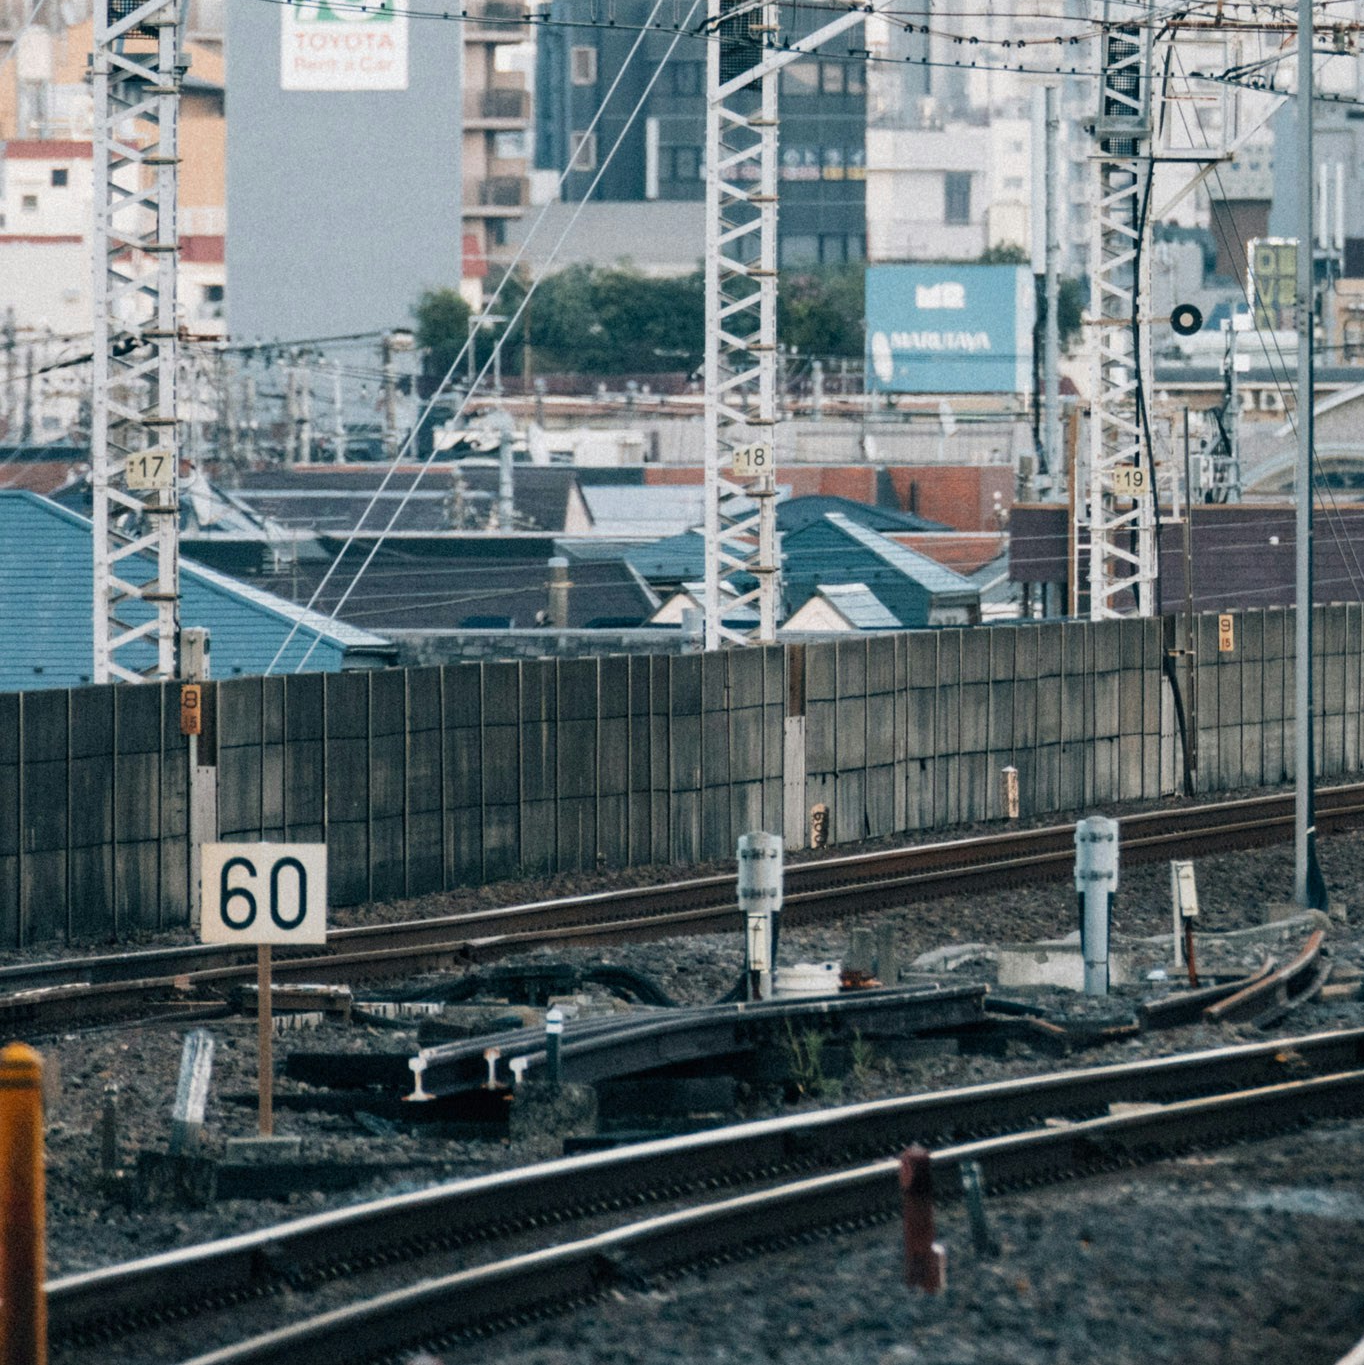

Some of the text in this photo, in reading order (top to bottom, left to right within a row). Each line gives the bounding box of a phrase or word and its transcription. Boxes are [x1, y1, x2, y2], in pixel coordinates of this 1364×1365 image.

[294, 32, 395, 51] TOYOTA
[743, 448, 765, 466] 18
[139, 456, 164, 478] 17
[1124, 471, 1143, 487] 19
[1221, 619, 1231, 632] 9
[185, 690, 198, 708] 8
[220, 856, 307, 930] 60
